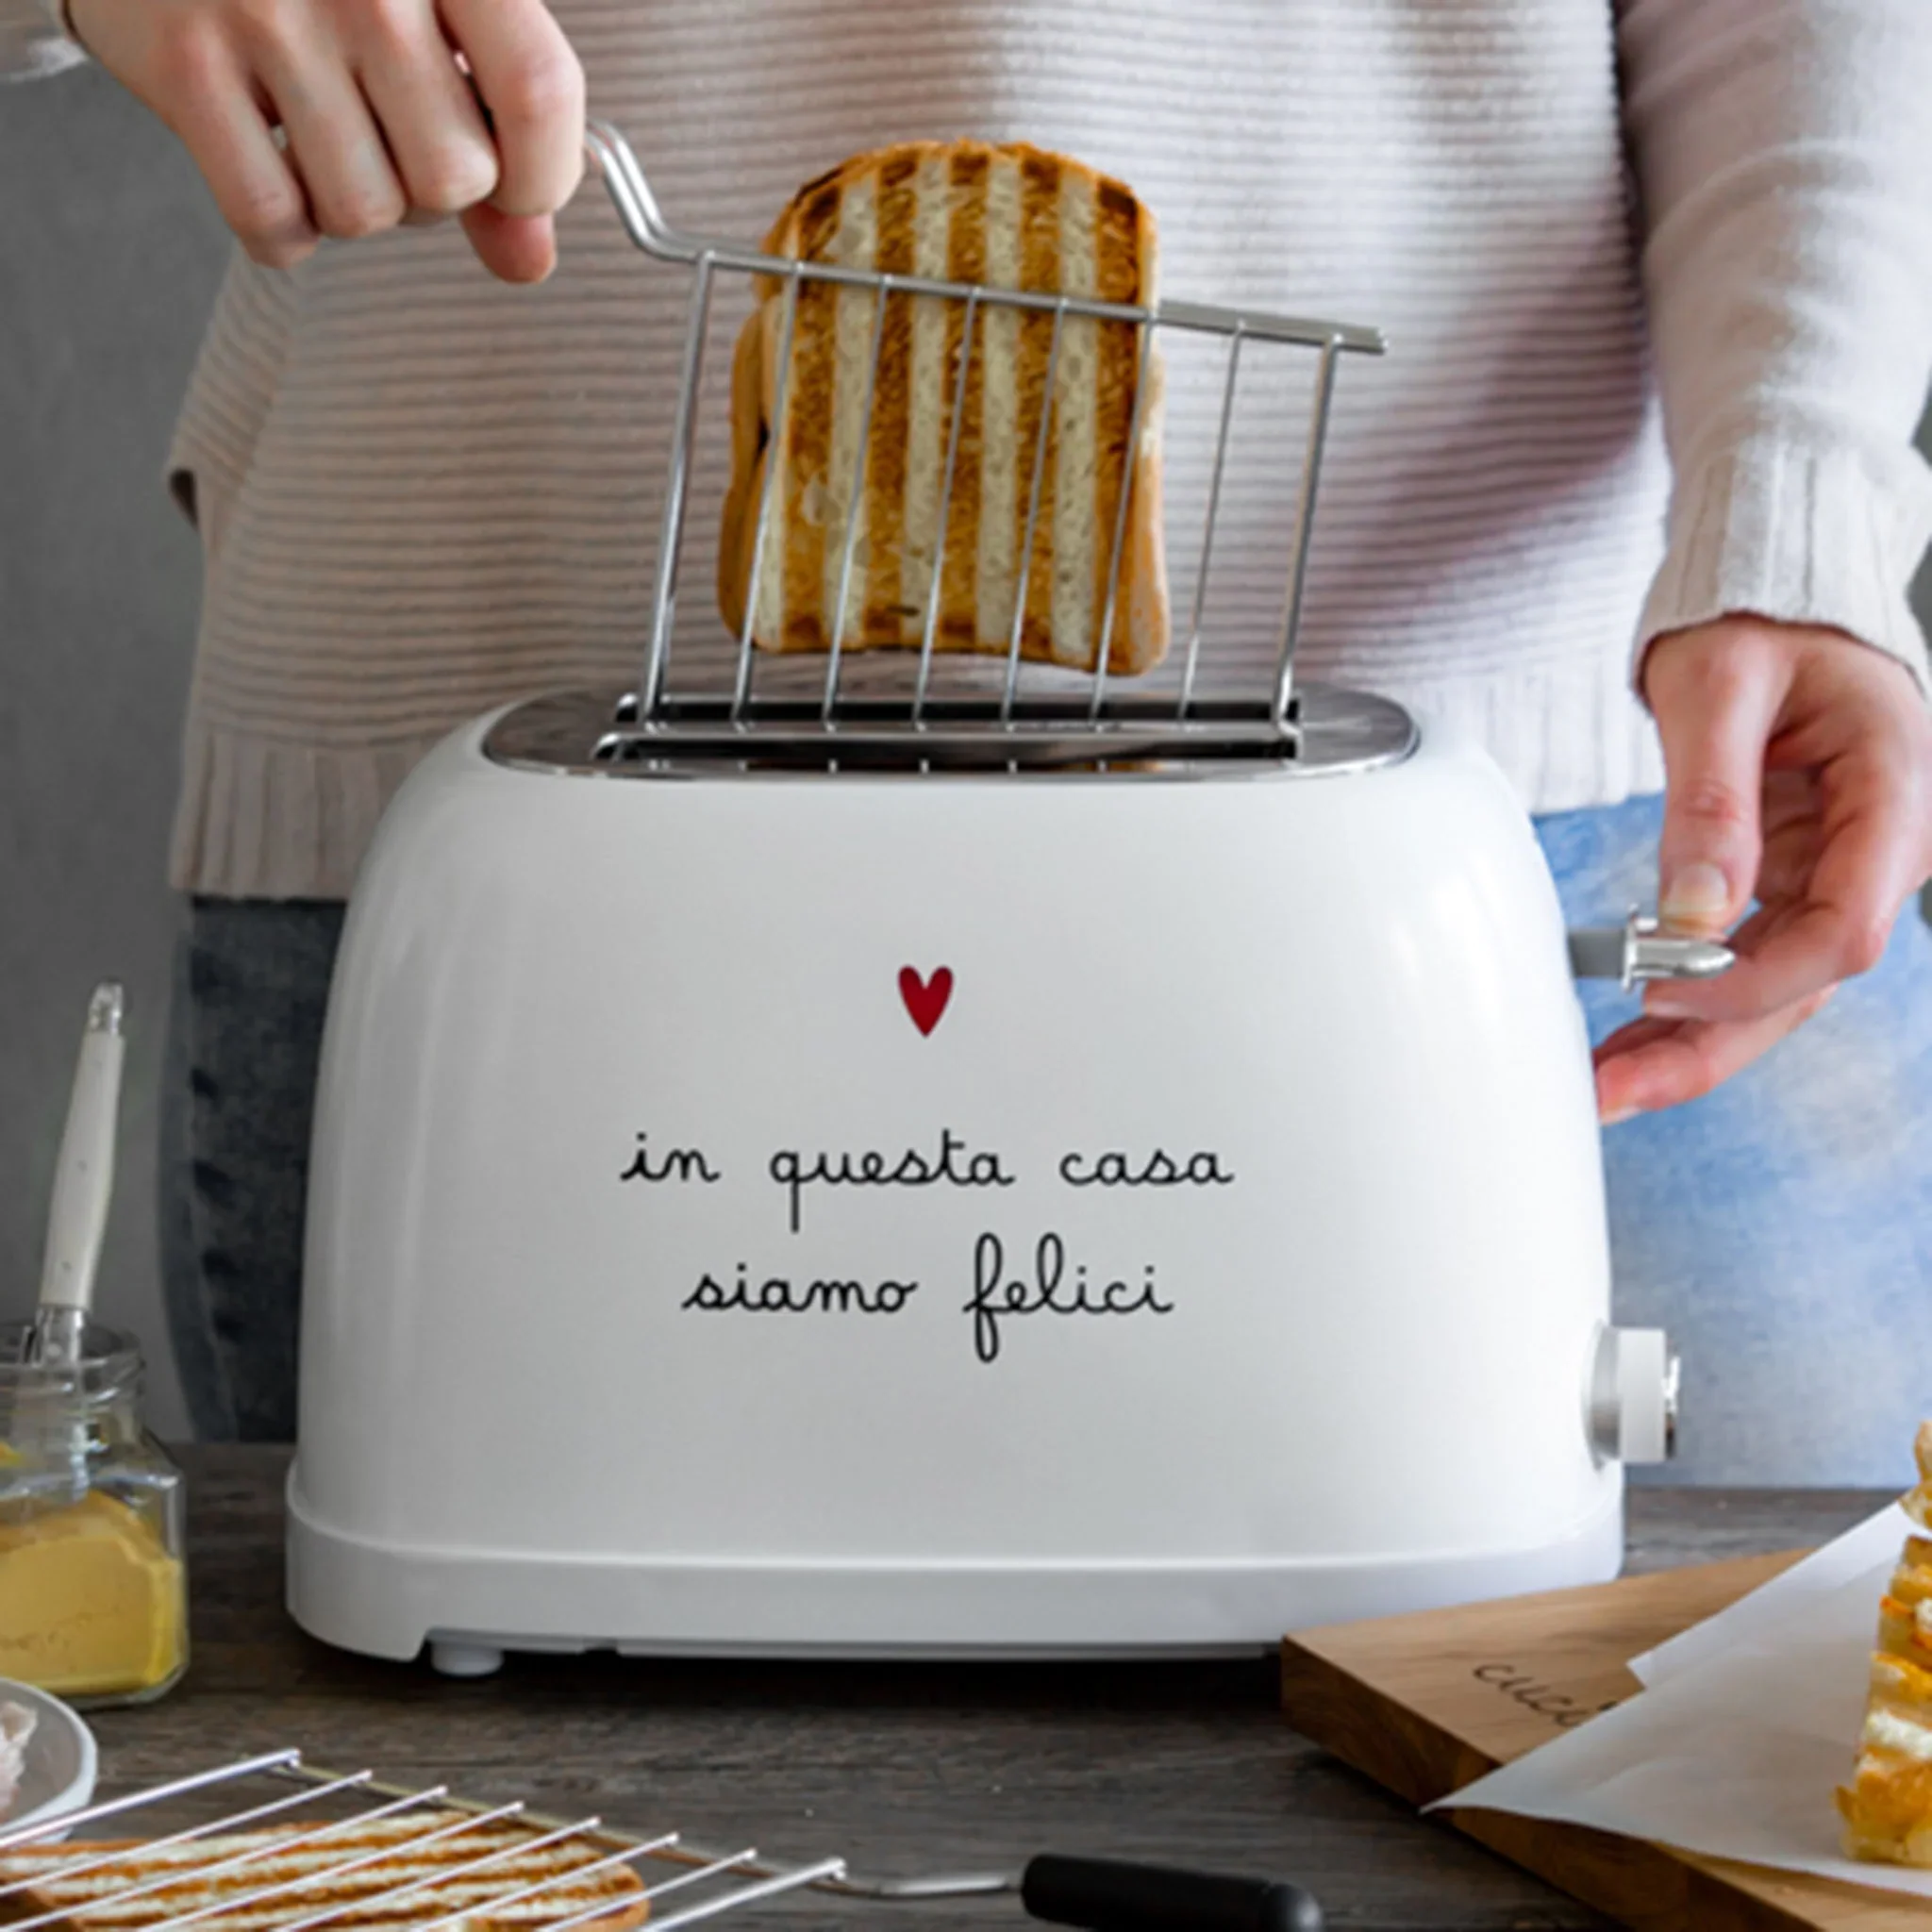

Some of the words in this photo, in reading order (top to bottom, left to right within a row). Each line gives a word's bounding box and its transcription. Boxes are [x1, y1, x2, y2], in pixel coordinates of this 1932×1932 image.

[619, 1131, 723, 1184] in
[769, 1128, 1016, 1234] questa
[1058, 1148, 1235, 1187] casa
[680, 1261, 919, 1314] siamo
[961, 1231, 1174, 1364] felici
